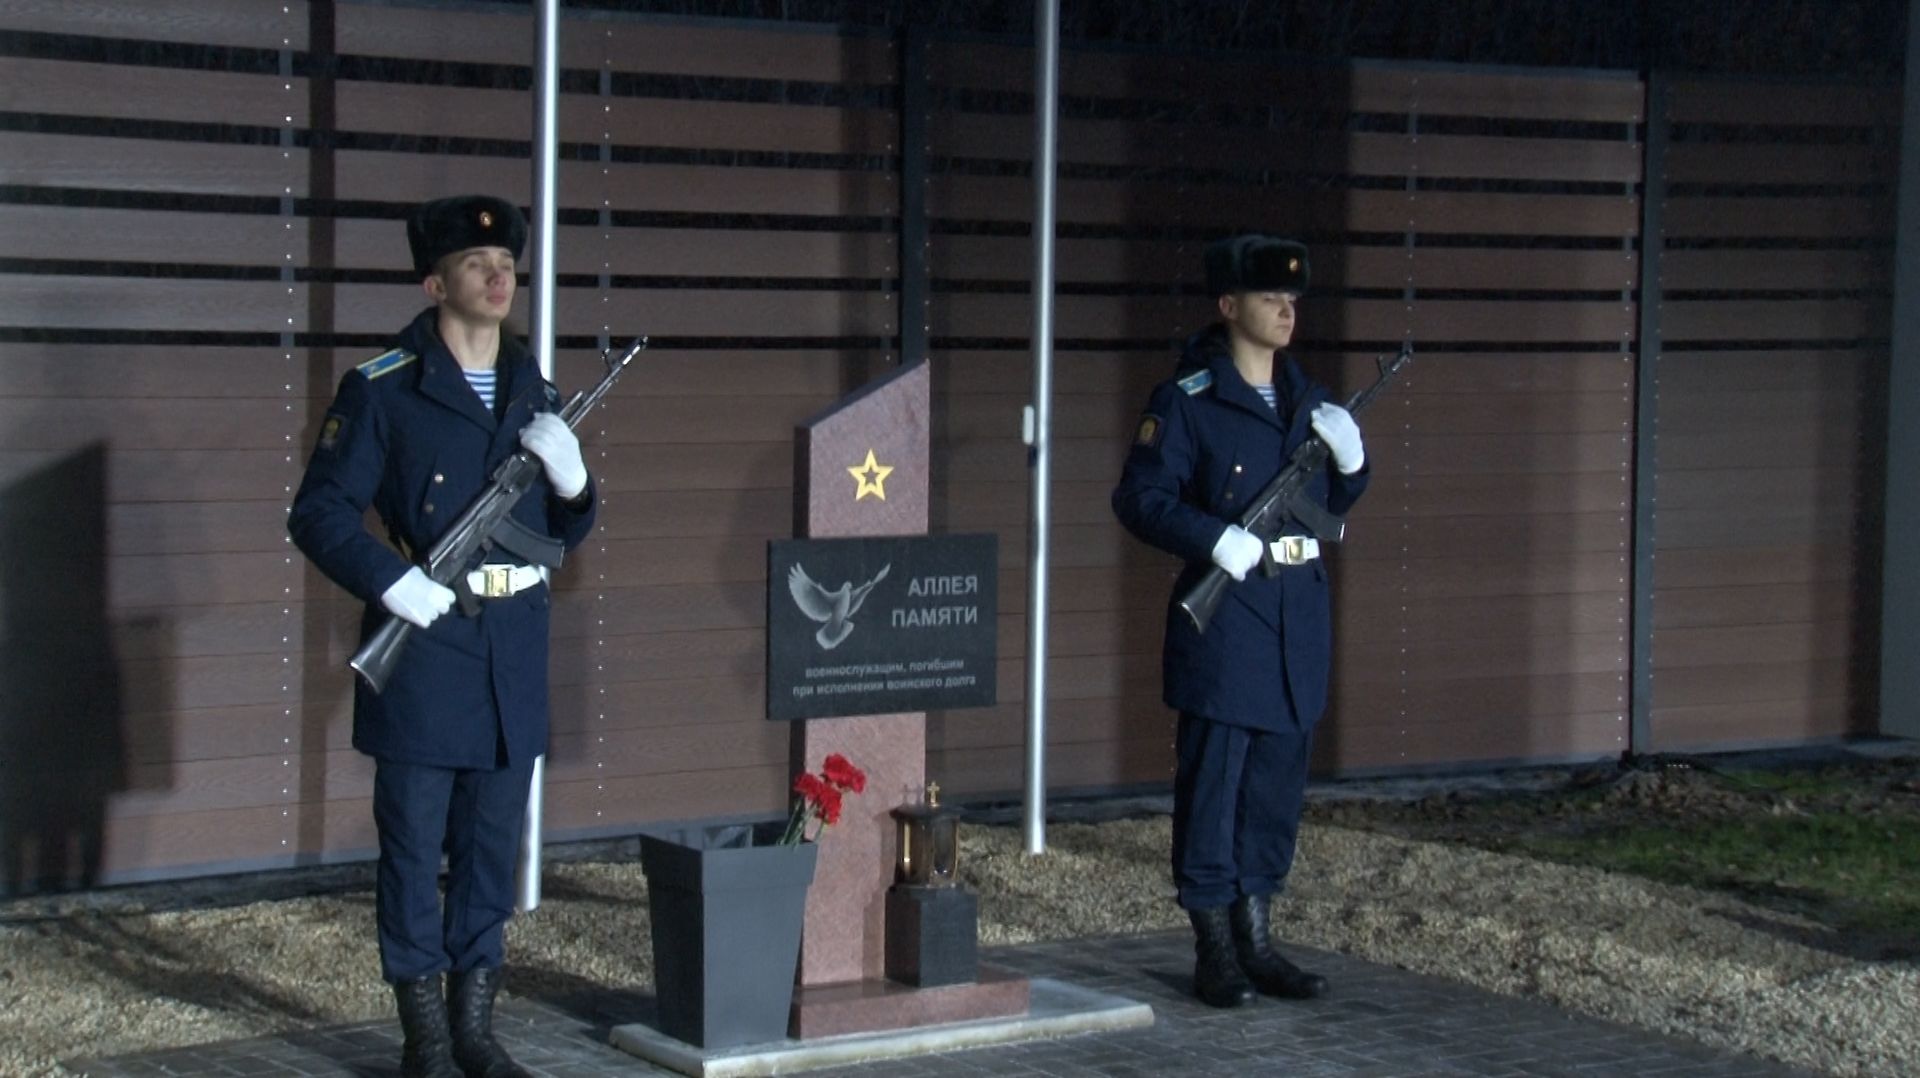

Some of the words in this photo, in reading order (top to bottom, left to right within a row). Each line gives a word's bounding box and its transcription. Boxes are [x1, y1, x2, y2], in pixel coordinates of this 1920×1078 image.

[908, 575, 978, 596] АЛЛЕЯ
[891, 606, 978, 627] ПАМЯТИ
[909, 658, 964, 672] погибшим
[792, 683, 814, 697] при
[887, 676, 943, 690] воинского
[944, 675, 976, 688] долга
